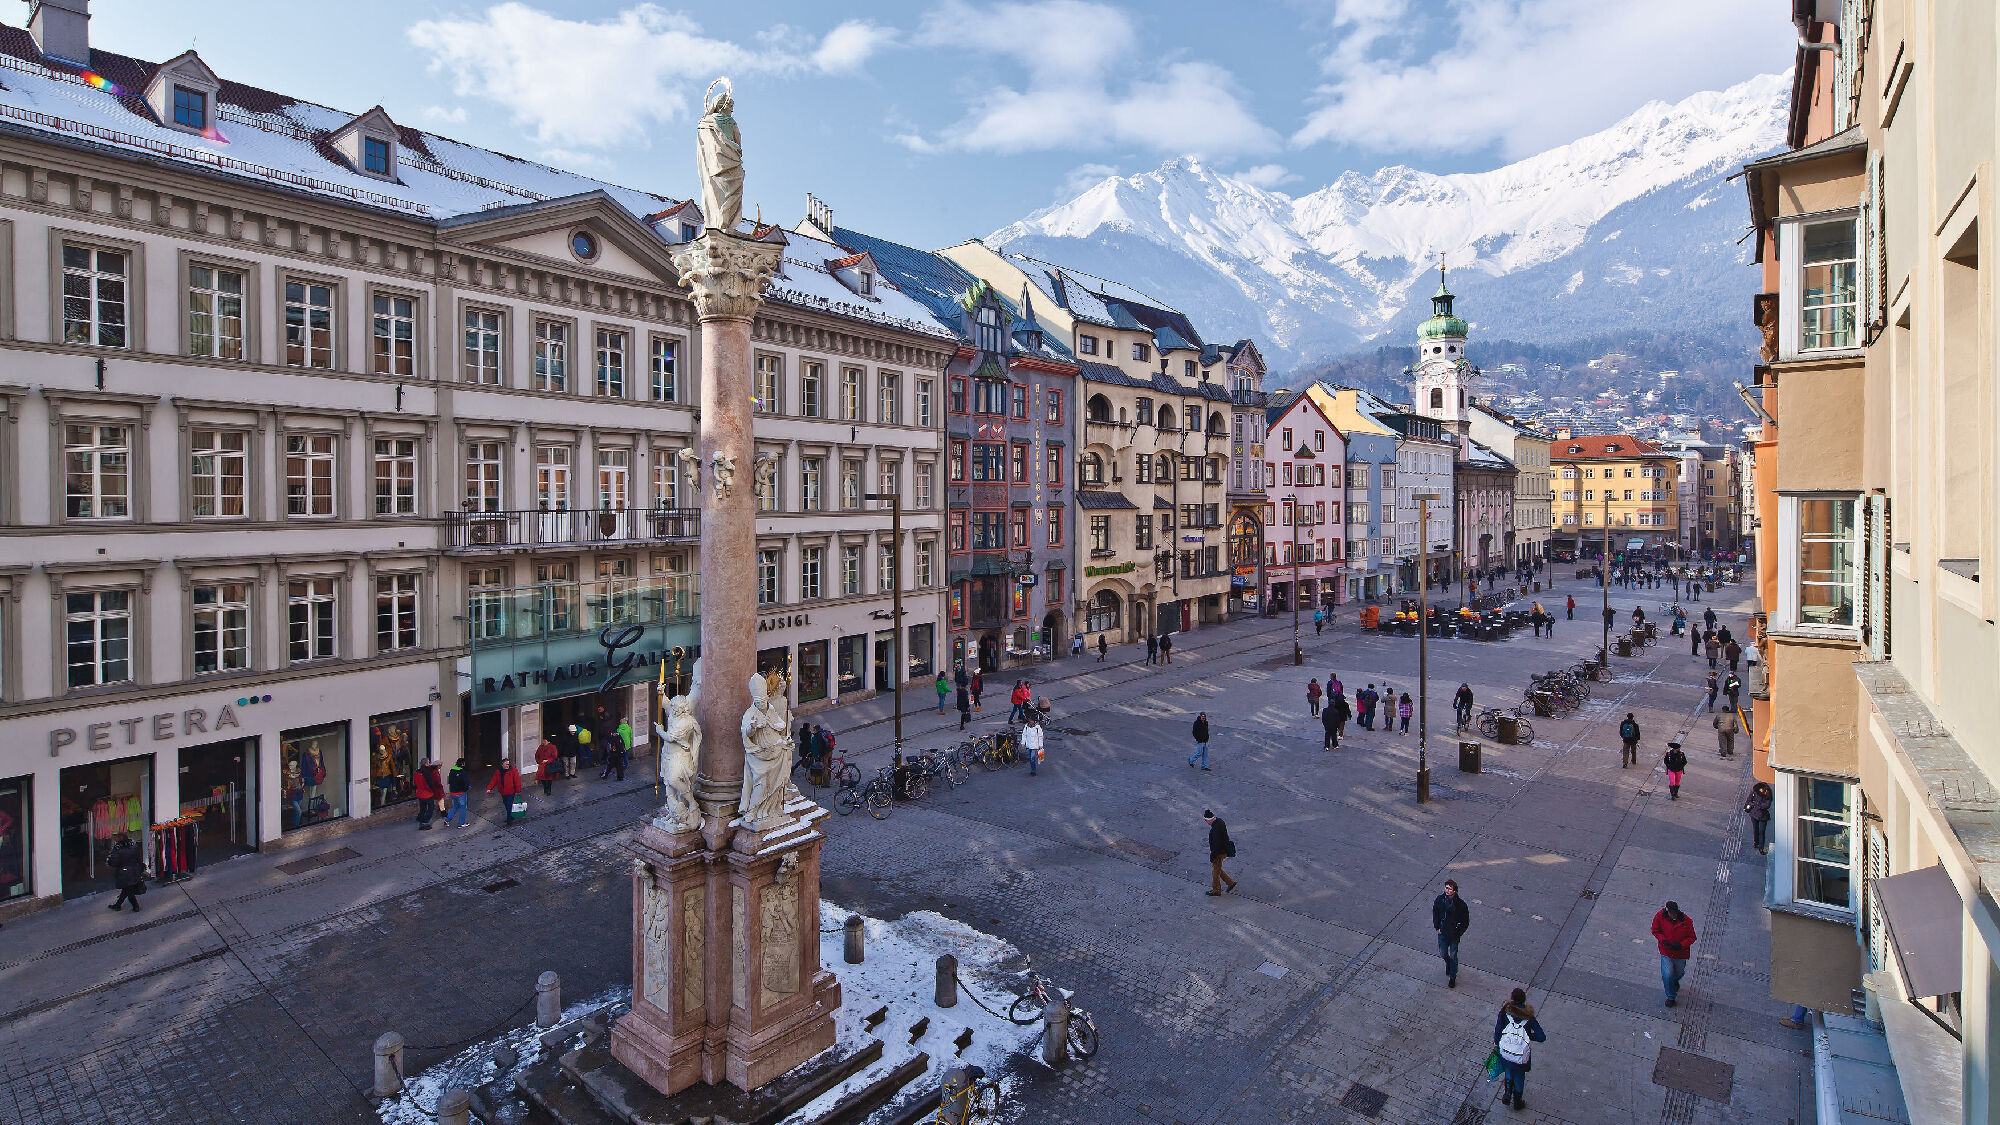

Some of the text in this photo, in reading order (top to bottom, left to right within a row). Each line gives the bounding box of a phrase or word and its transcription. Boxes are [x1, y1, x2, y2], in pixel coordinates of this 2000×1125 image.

[483, 625, 701, 693] RATHAUS GALEI
[50, 704, 240, 757] PETERA
